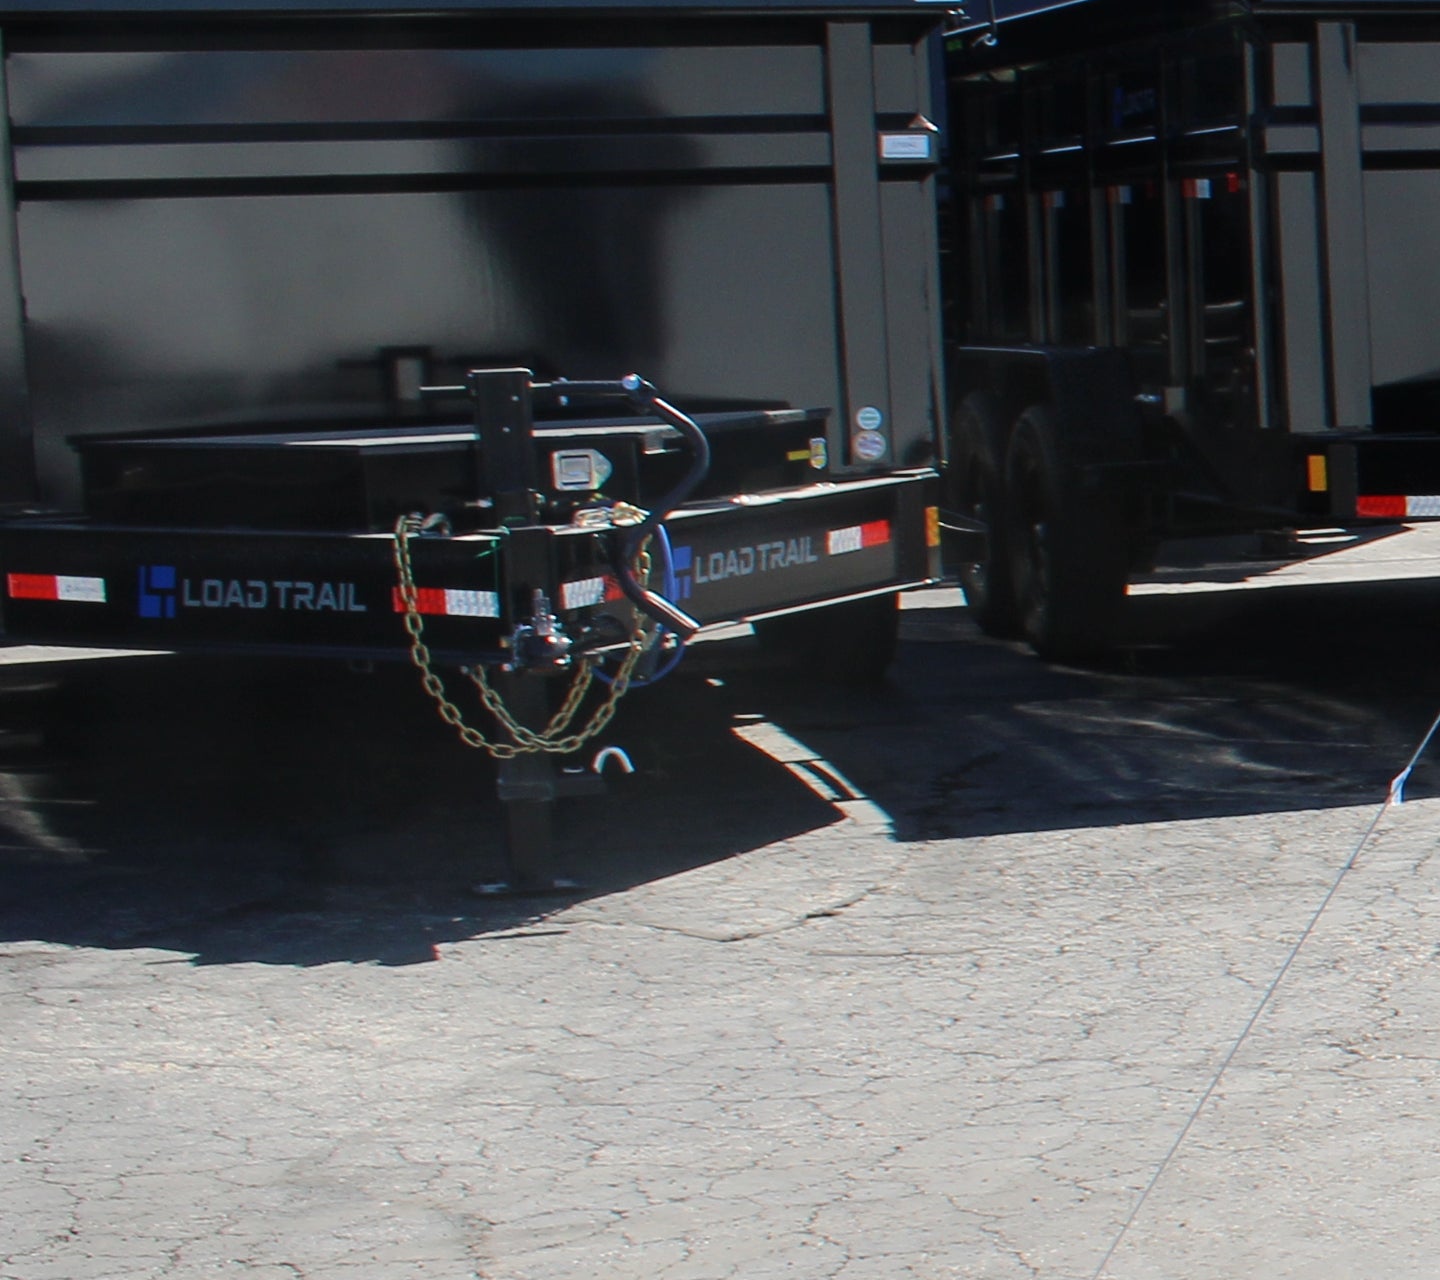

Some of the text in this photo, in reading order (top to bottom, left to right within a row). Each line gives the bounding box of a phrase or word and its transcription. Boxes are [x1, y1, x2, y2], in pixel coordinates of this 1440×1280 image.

[695, 536, 818, 584] LOAD TRAIL
[182, 579, 367, 612] LOAD TRAIL
